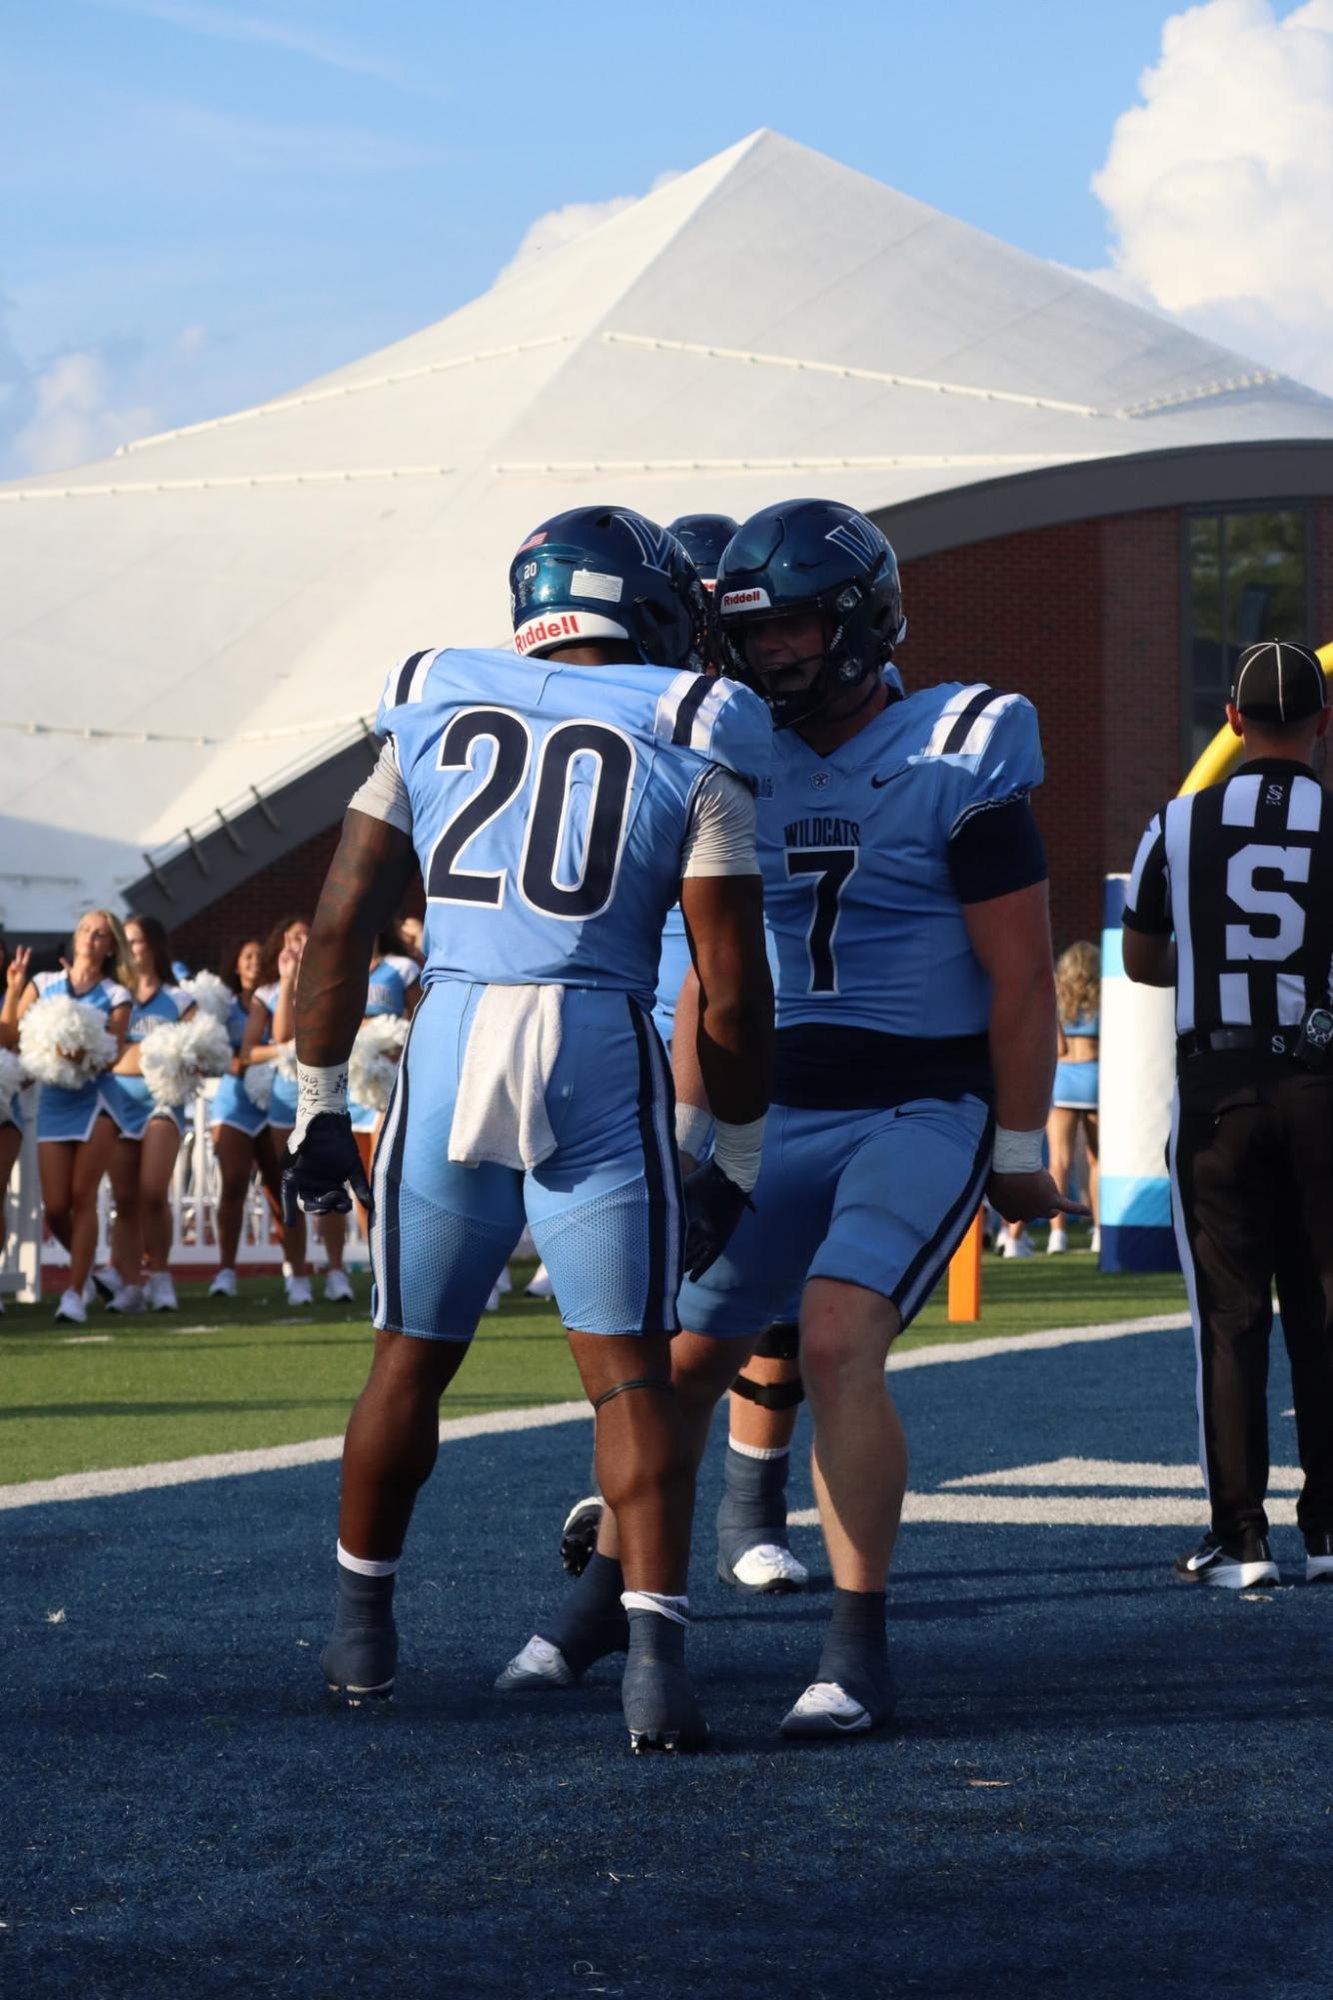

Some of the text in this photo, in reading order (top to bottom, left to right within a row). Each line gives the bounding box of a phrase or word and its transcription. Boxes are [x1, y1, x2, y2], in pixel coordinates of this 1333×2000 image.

[523, 561, 537, 580] 20
[724, 590, 761, 606] Riddell
[514, 618, 580, 655] Riddell
[425, 705, 637, 921] 20
[783, 817, 861, 847] WILDCATS
[1225, 843, 1312, 962] S
[783, 846, 860, 996] 7
[1271, 1034, 1286, 1055] S
